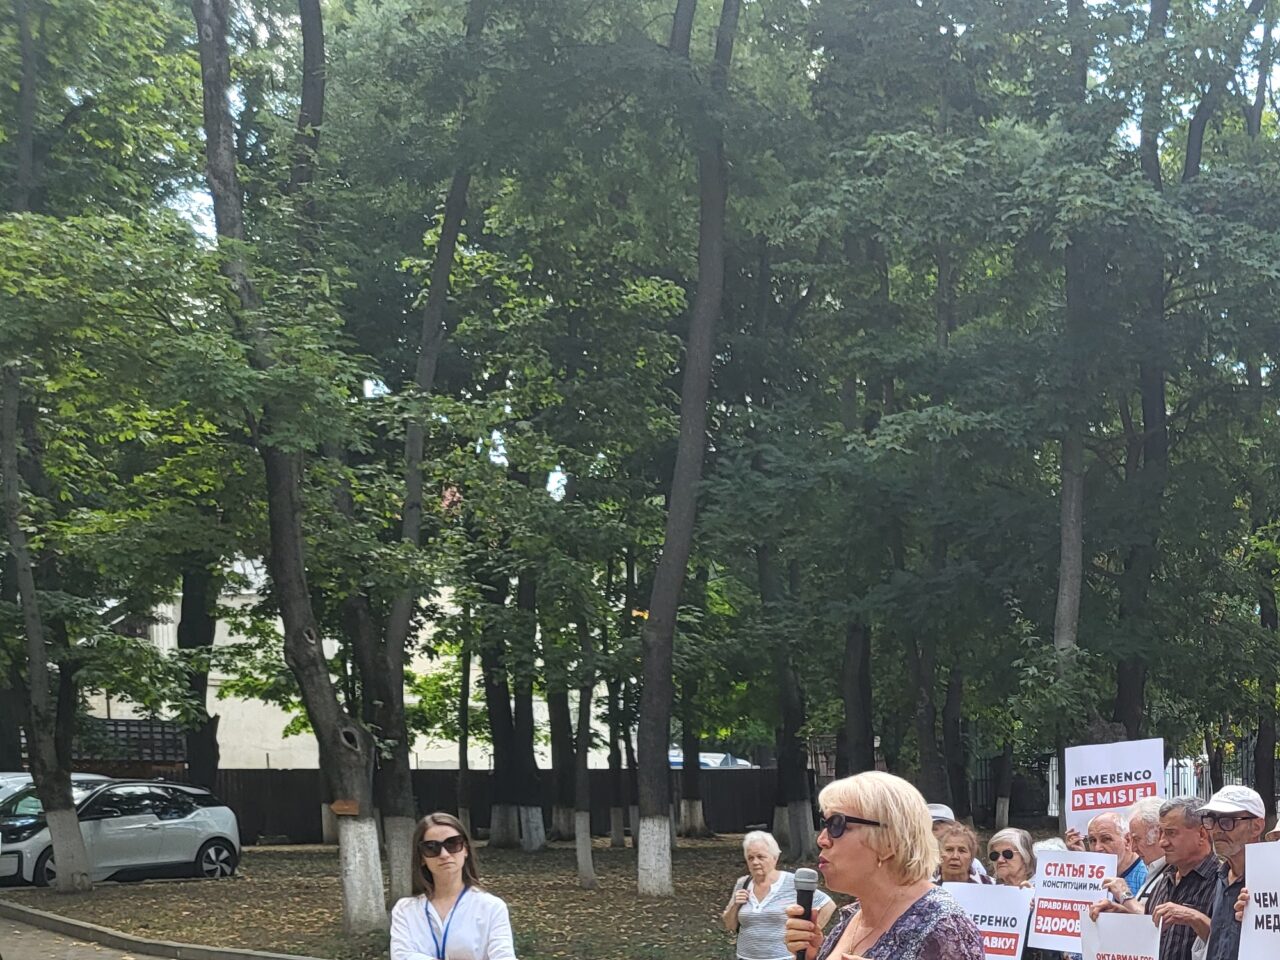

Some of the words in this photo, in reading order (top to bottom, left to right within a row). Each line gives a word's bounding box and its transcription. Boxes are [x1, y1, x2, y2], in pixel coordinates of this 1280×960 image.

[1074, 769, 1152, 787] NEMERENCO
[1073, 786, 1152, 807] DEMISIE!
[1045, 862, 1085, 878] СТАТЬЯ
[1088, 864, 1106, 879] 36
[1042, 880, 1088, 891] КОНСТИТУЦИИ
[1038, 900, 1062, 910] ПРАВО
[1062, 902, 1072, 911] НА
[1072, 903, 1091, 912] ОХРА
[1254, 891, 1279, 908] ЧЕМ
[969, 914, 1018, 928] ЕРЕНКО
[982, 936, 1016, 950] АВКУ!
